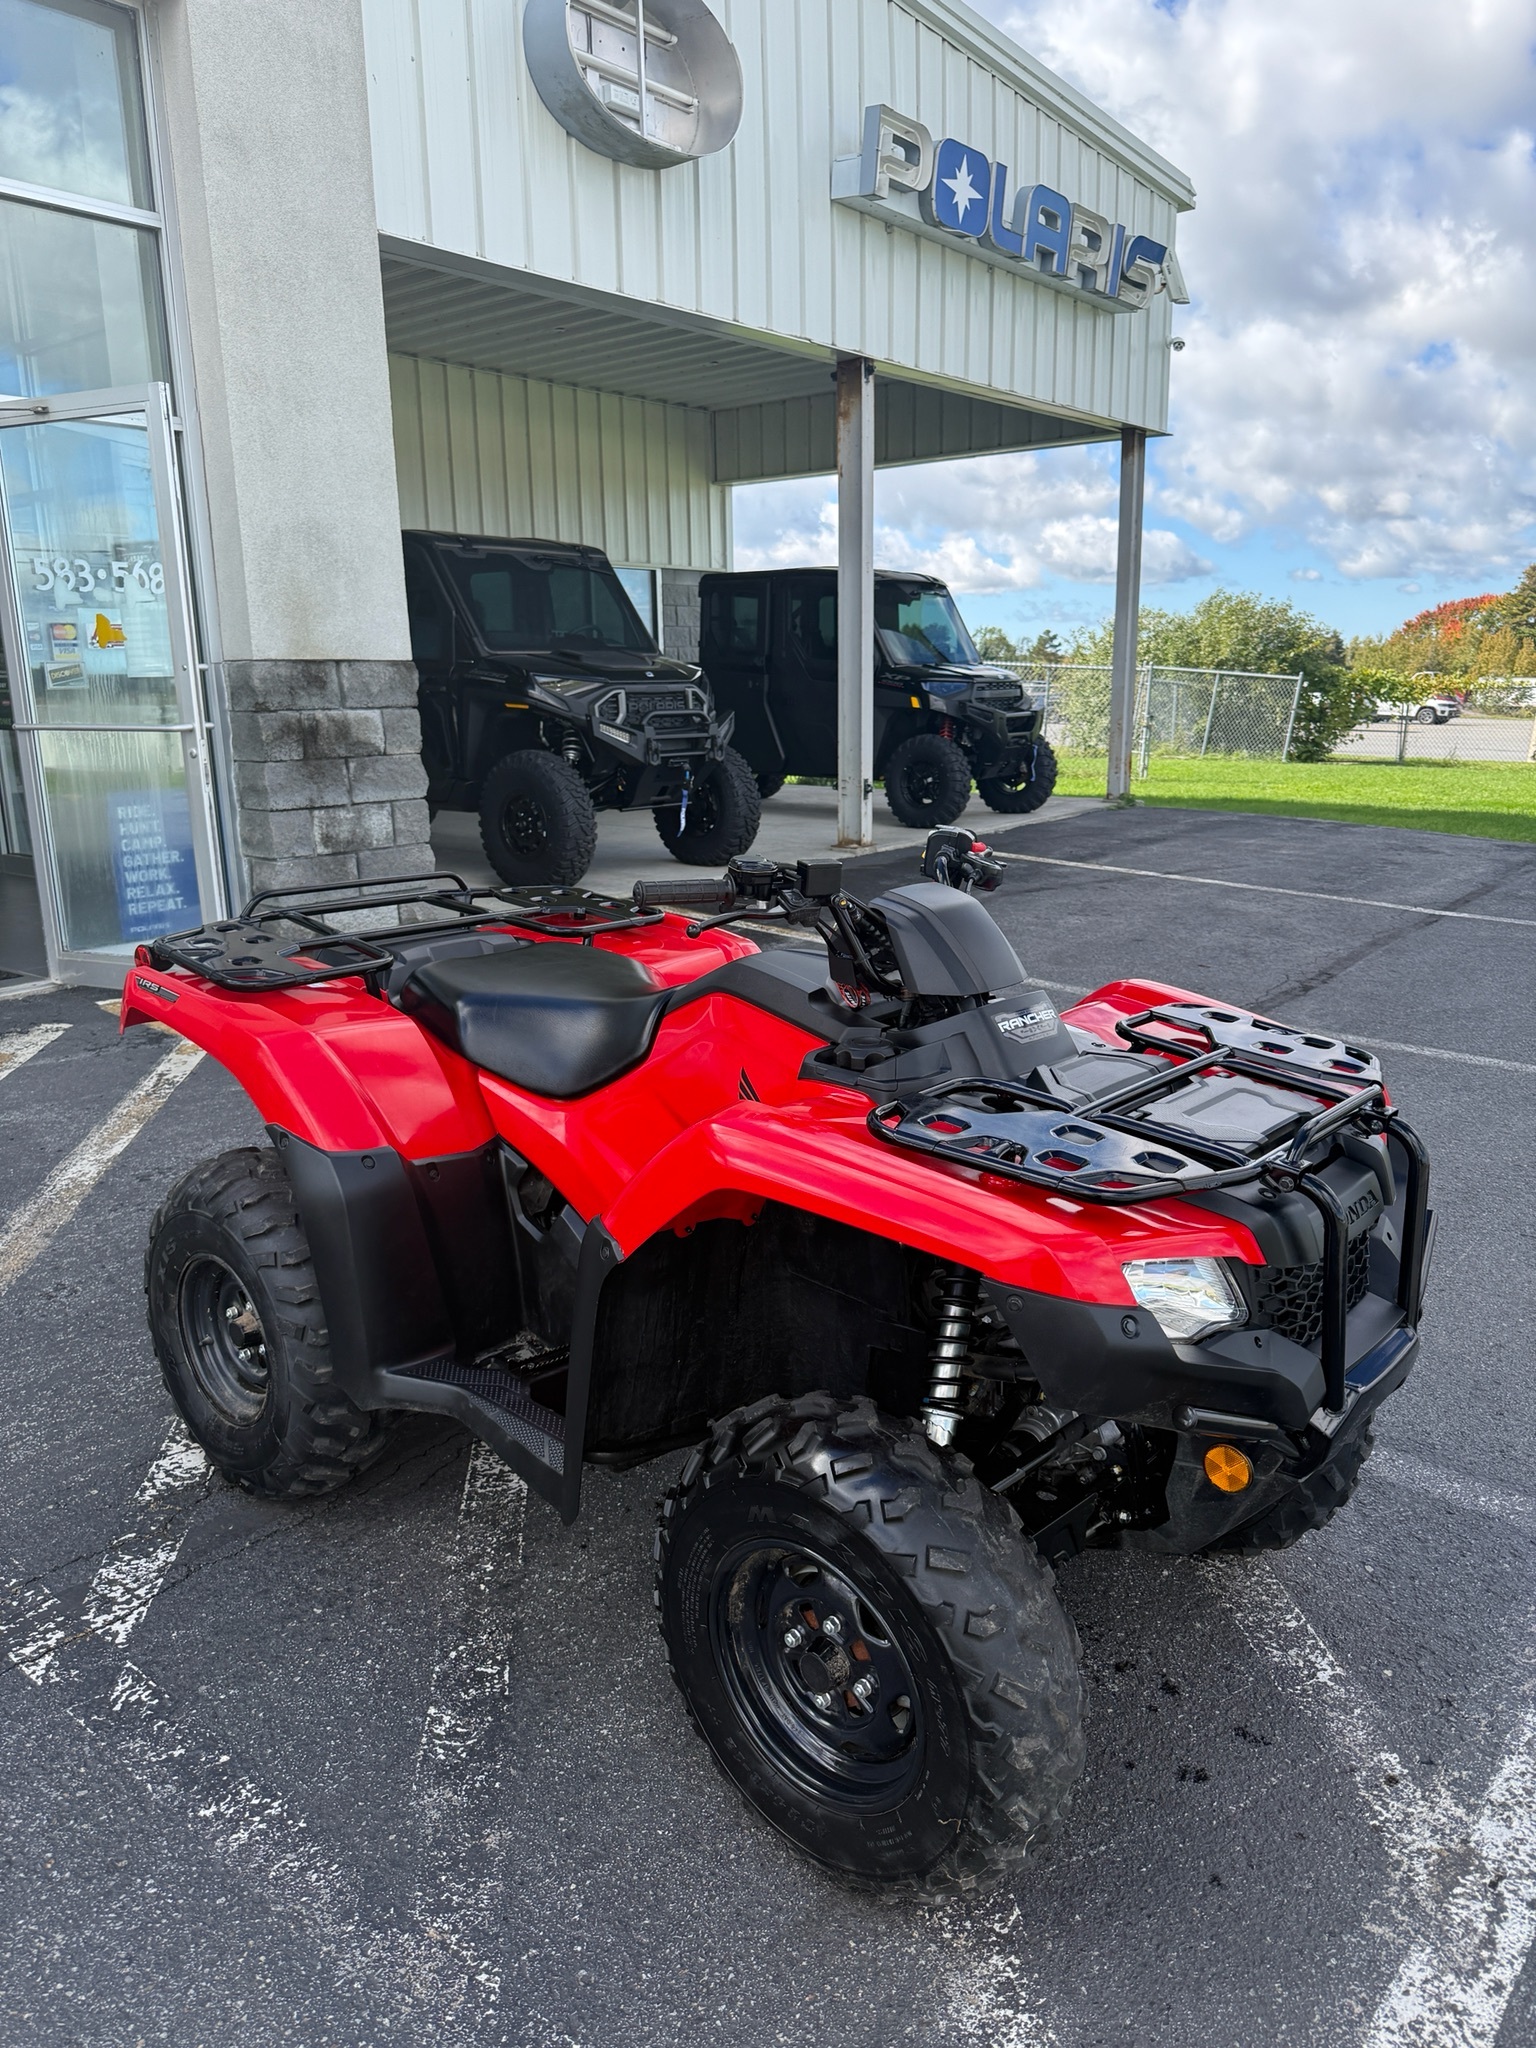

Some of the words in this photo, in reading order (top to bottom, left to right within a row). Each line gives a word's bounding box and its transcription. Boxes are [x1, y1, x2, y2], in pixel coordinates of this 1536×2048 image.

[860, 103, 1167, 310] POLARIS
[121, 837, 167, 852] CAMP.
[123, 850, 184, 868] GATHER.
[125, 867, 172, 884] WORK.
[127, 882, 180, 900] RELAX.
[128, 897, 187, 916] REPEAT.
[139, 978, 160, 992] IRS
[998, 1009, 1057, 1033] RANCHER
[1345, 1189, 1381, 1225] NDA
